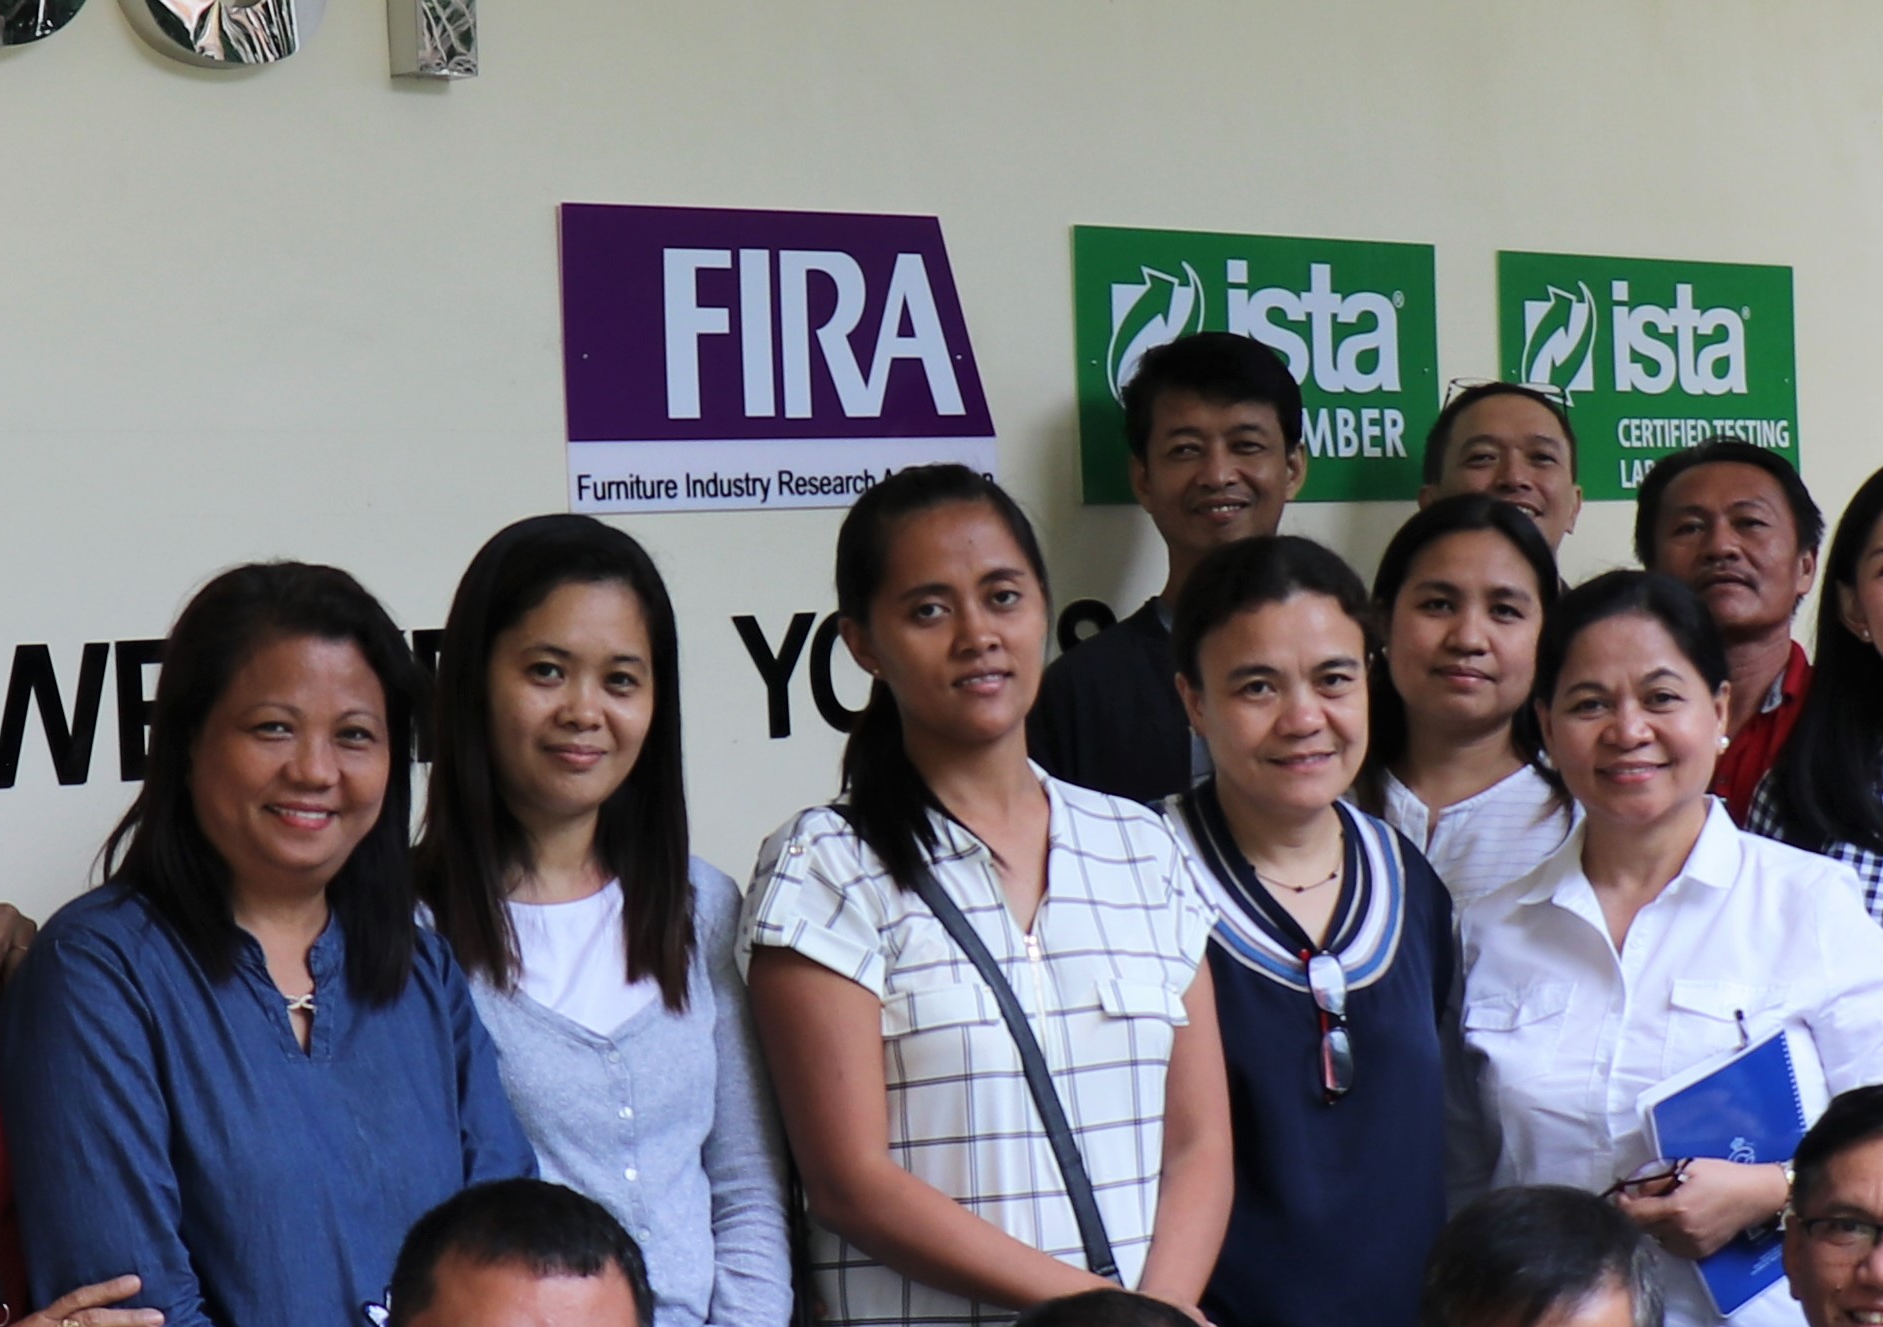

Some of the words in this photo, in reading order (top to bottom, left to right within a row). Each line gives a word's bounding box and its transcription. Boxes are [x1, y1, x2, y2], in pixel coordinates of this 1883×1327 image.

[663, 248, 966, 418] FIRA
[1302, 408, 1407, 457] MBER
[1618, 418, 1710, 448] CERTIFIED
[1713, 419, 1790, 448] TESTING
[577, 473, 678, 501] Furniture
[686, 471, 770, 503] Industry
[777, 469, 875, 496] Research
